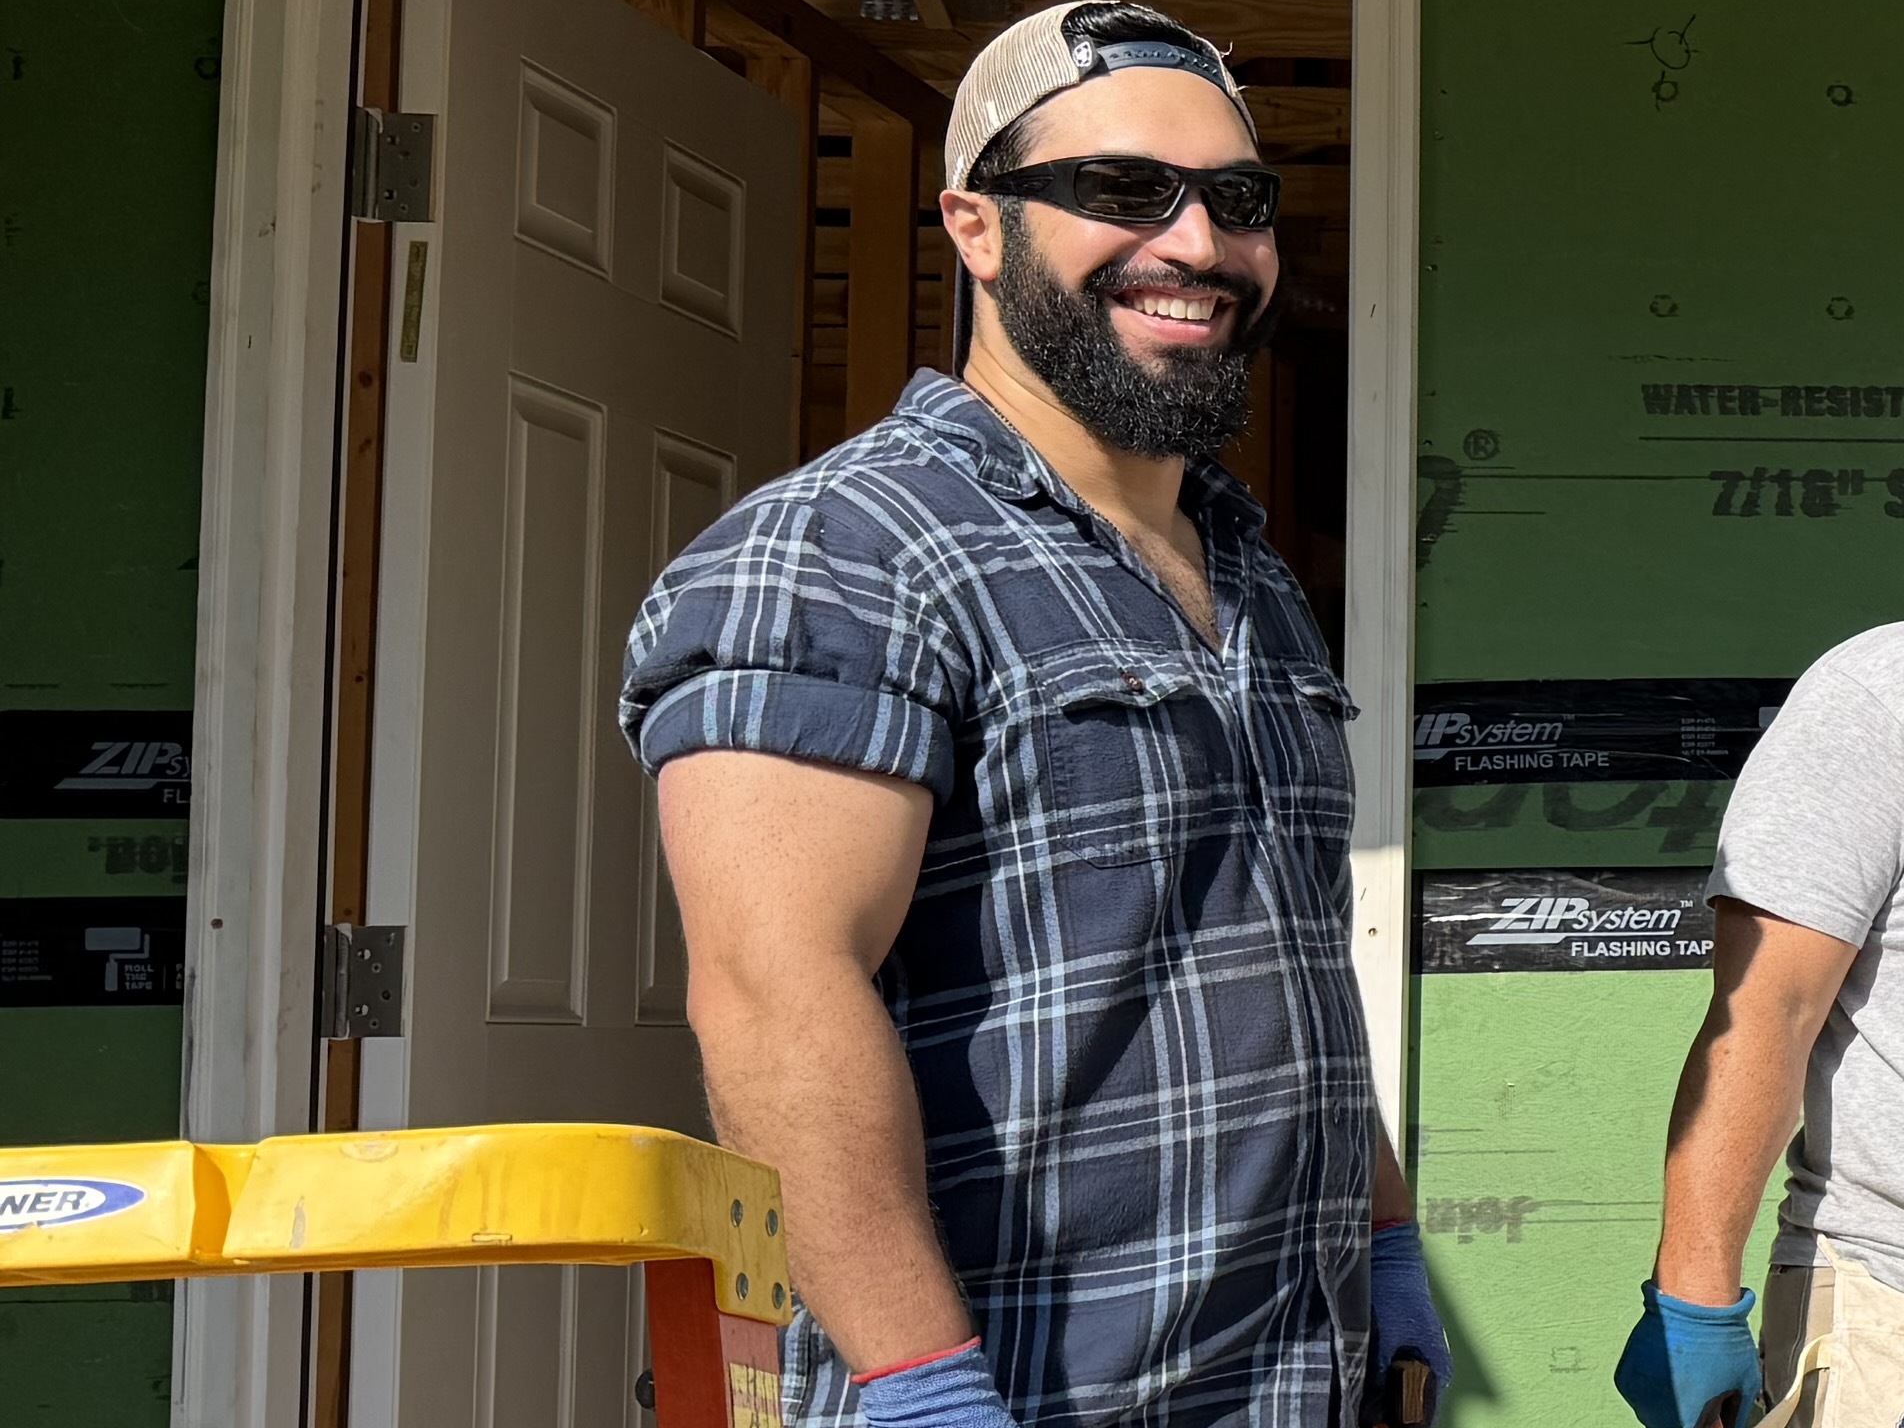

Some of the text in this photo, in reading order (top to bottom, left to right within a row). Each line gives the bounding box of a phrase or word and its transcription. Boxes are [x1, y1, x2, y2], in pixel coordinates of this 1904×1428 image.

[1454, 752, 1610, 771] FLASHING TAPE
[1571, 941, 1671, 957] FLASHING
